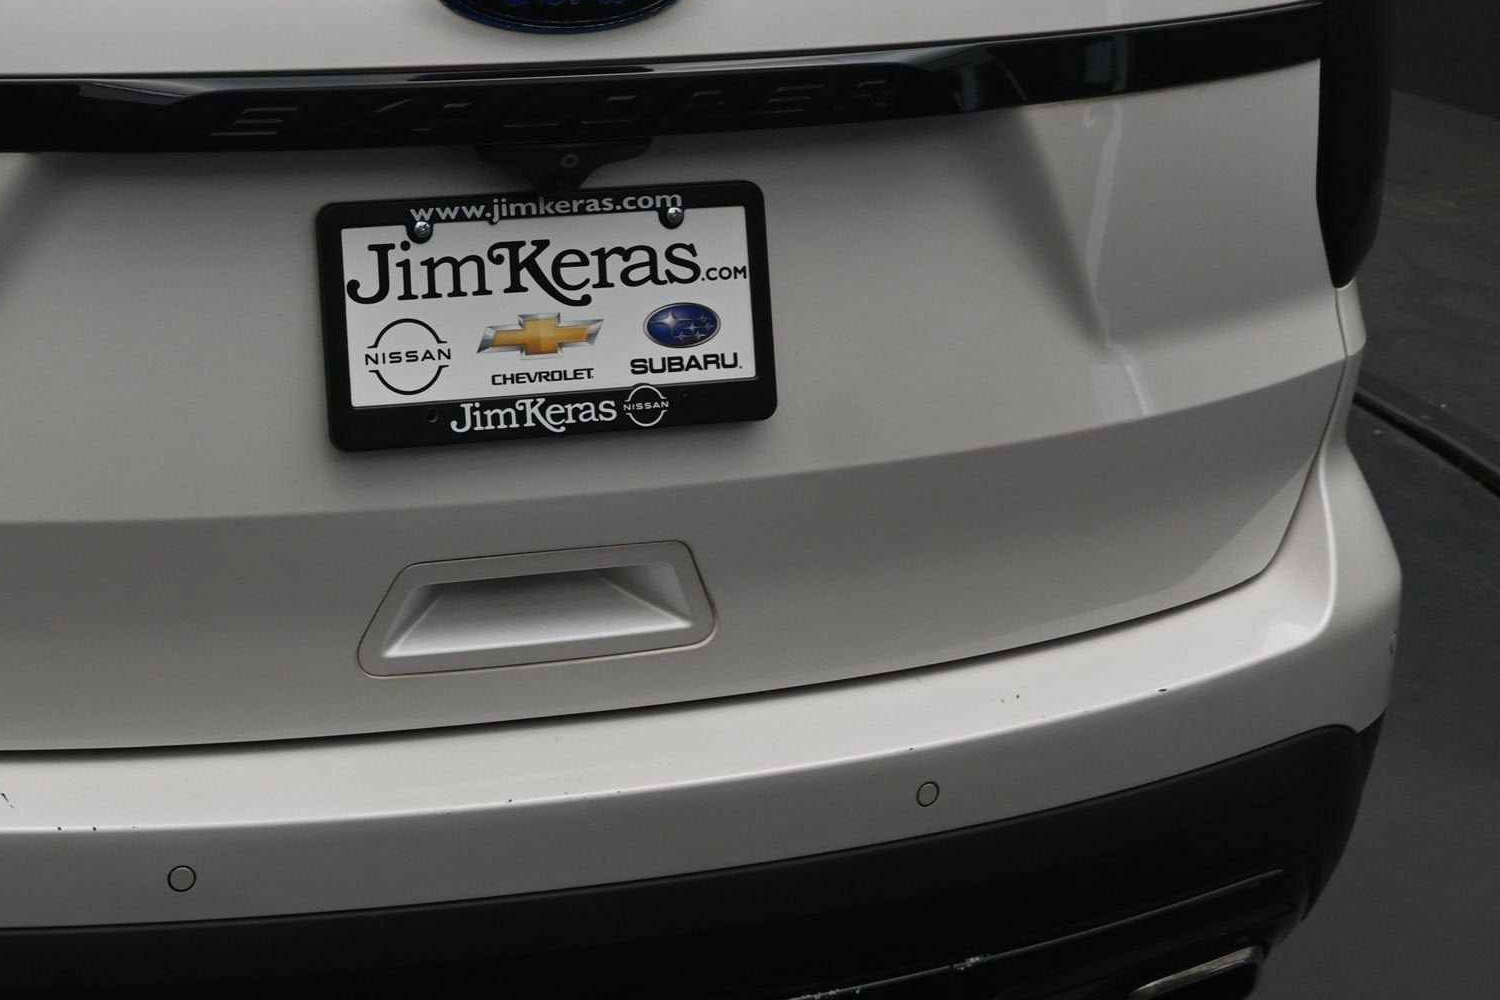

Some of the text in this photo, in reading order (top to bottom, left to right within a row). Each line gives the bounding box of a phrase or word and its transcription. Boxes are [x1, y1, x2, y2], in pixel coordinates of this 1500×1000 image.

[409, 192, 682, 223] www.jimkeras.com
[365, 348, 451, 365] NISSAN
[630, 352, 738, 374] SUBARU
[491, 368, 594, 385] CHEVROLET
[623, 399, 669, 411] NISSAN
